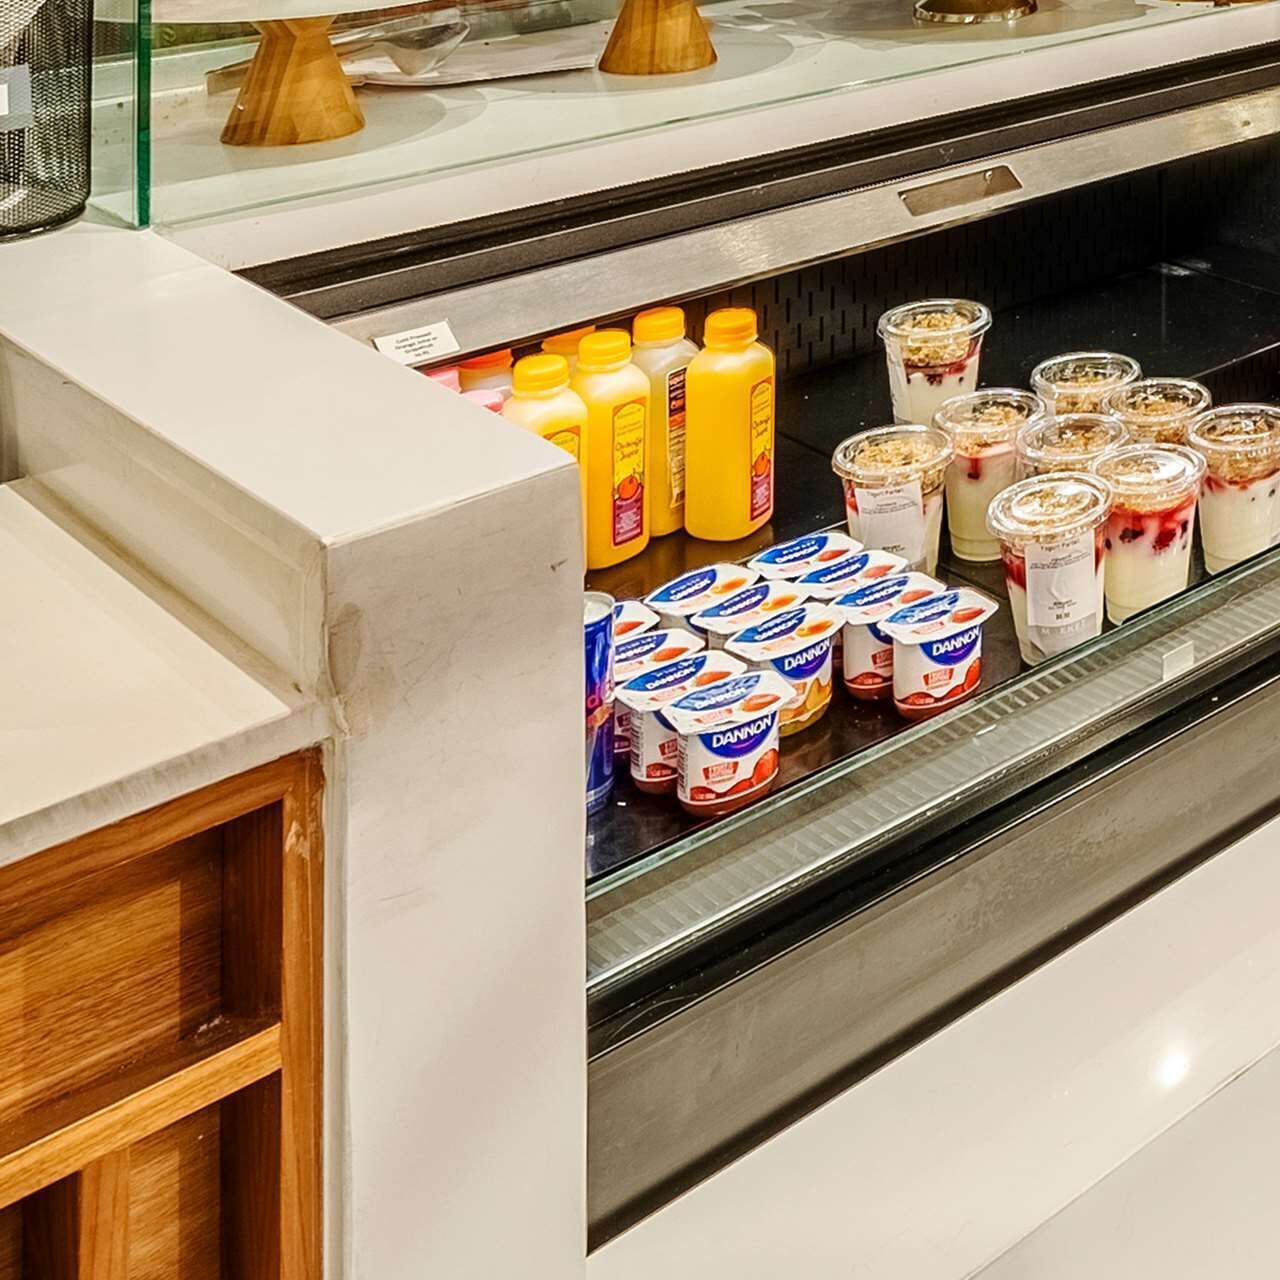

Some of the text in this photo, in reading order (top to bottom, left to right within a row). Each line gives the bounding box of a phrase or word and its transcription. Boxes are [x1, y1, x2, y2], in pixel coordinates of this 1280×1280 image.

[615, 437, 643, 454] Orange
[619, 448, 639, 462] Juice
[775, 544, 820, 564] DANNON
[820, 563, 863, 583] DANNON
[669, 577, 712, 601] DANNON
[857, 585, 904, 606] DANNON
[719, 594, 763, 616] DANNON
[906, 603, 954, 623] DANNON
[754, 618, 800, 641] DANNON
[615, 642, 657, 662] ANNON
[932, 627, 981, 656] DANNON
[784, 639, 831, 671] DANNON
[645, 667, 697, 690] DANNON
[693, 686, 748, 709] DANNON
[711, 716, 772, 748] DANNON
